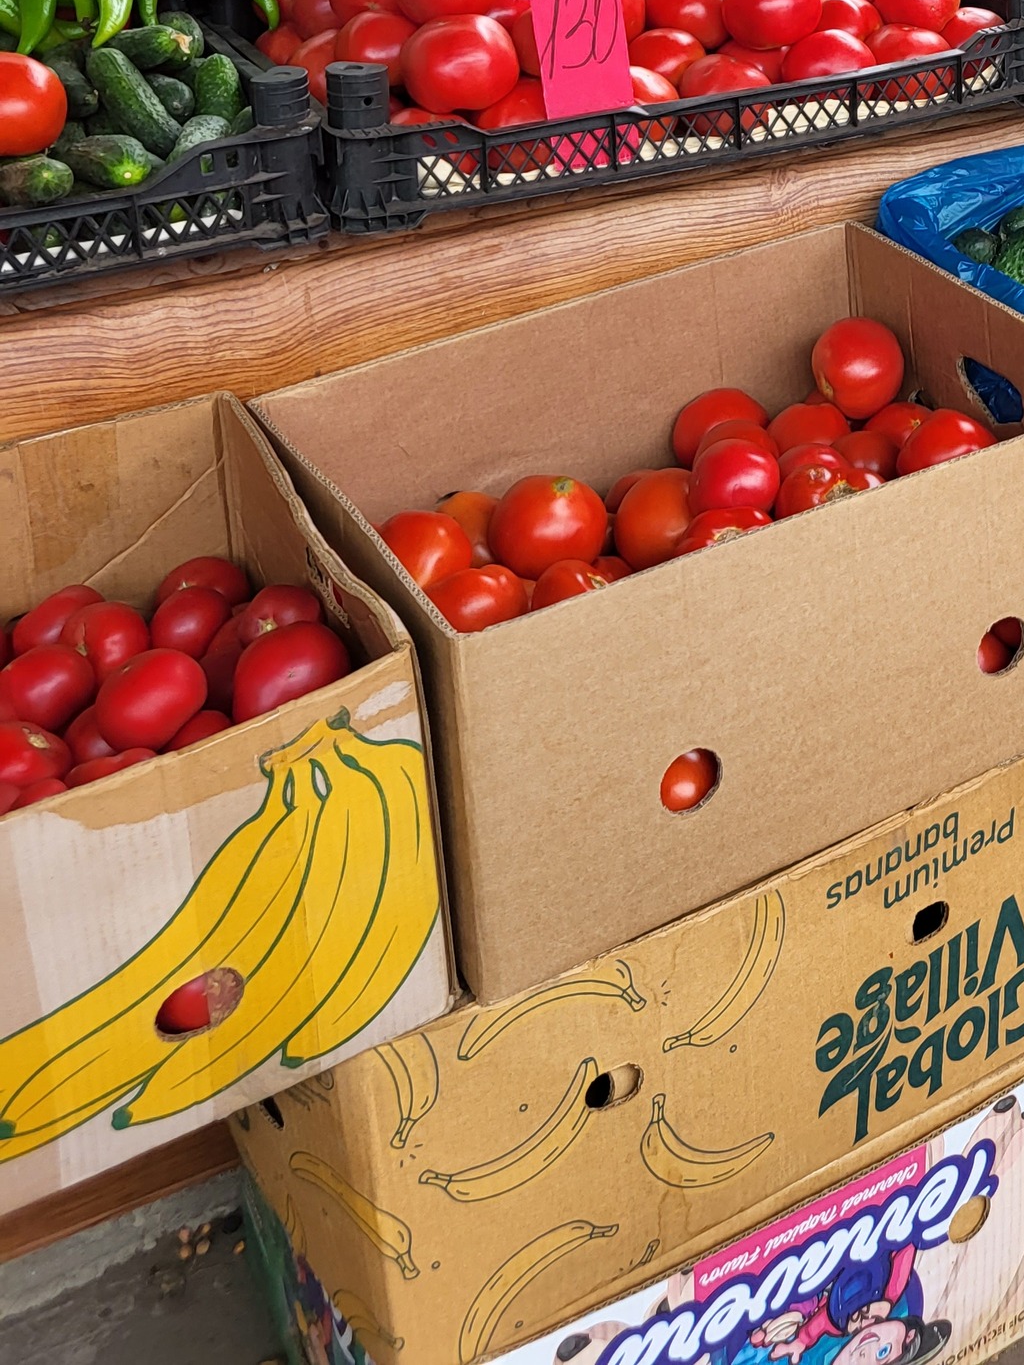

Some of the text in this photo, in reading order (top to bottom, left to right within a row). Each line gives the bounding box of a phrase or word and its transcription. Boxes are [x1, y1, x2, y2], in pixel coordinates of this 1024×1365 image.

[826, 811, 960, 911] bananas
[881, 808, 1015, 910] Premium
[699, 1162, 919, 1288] Charmed Tropical Flavor
